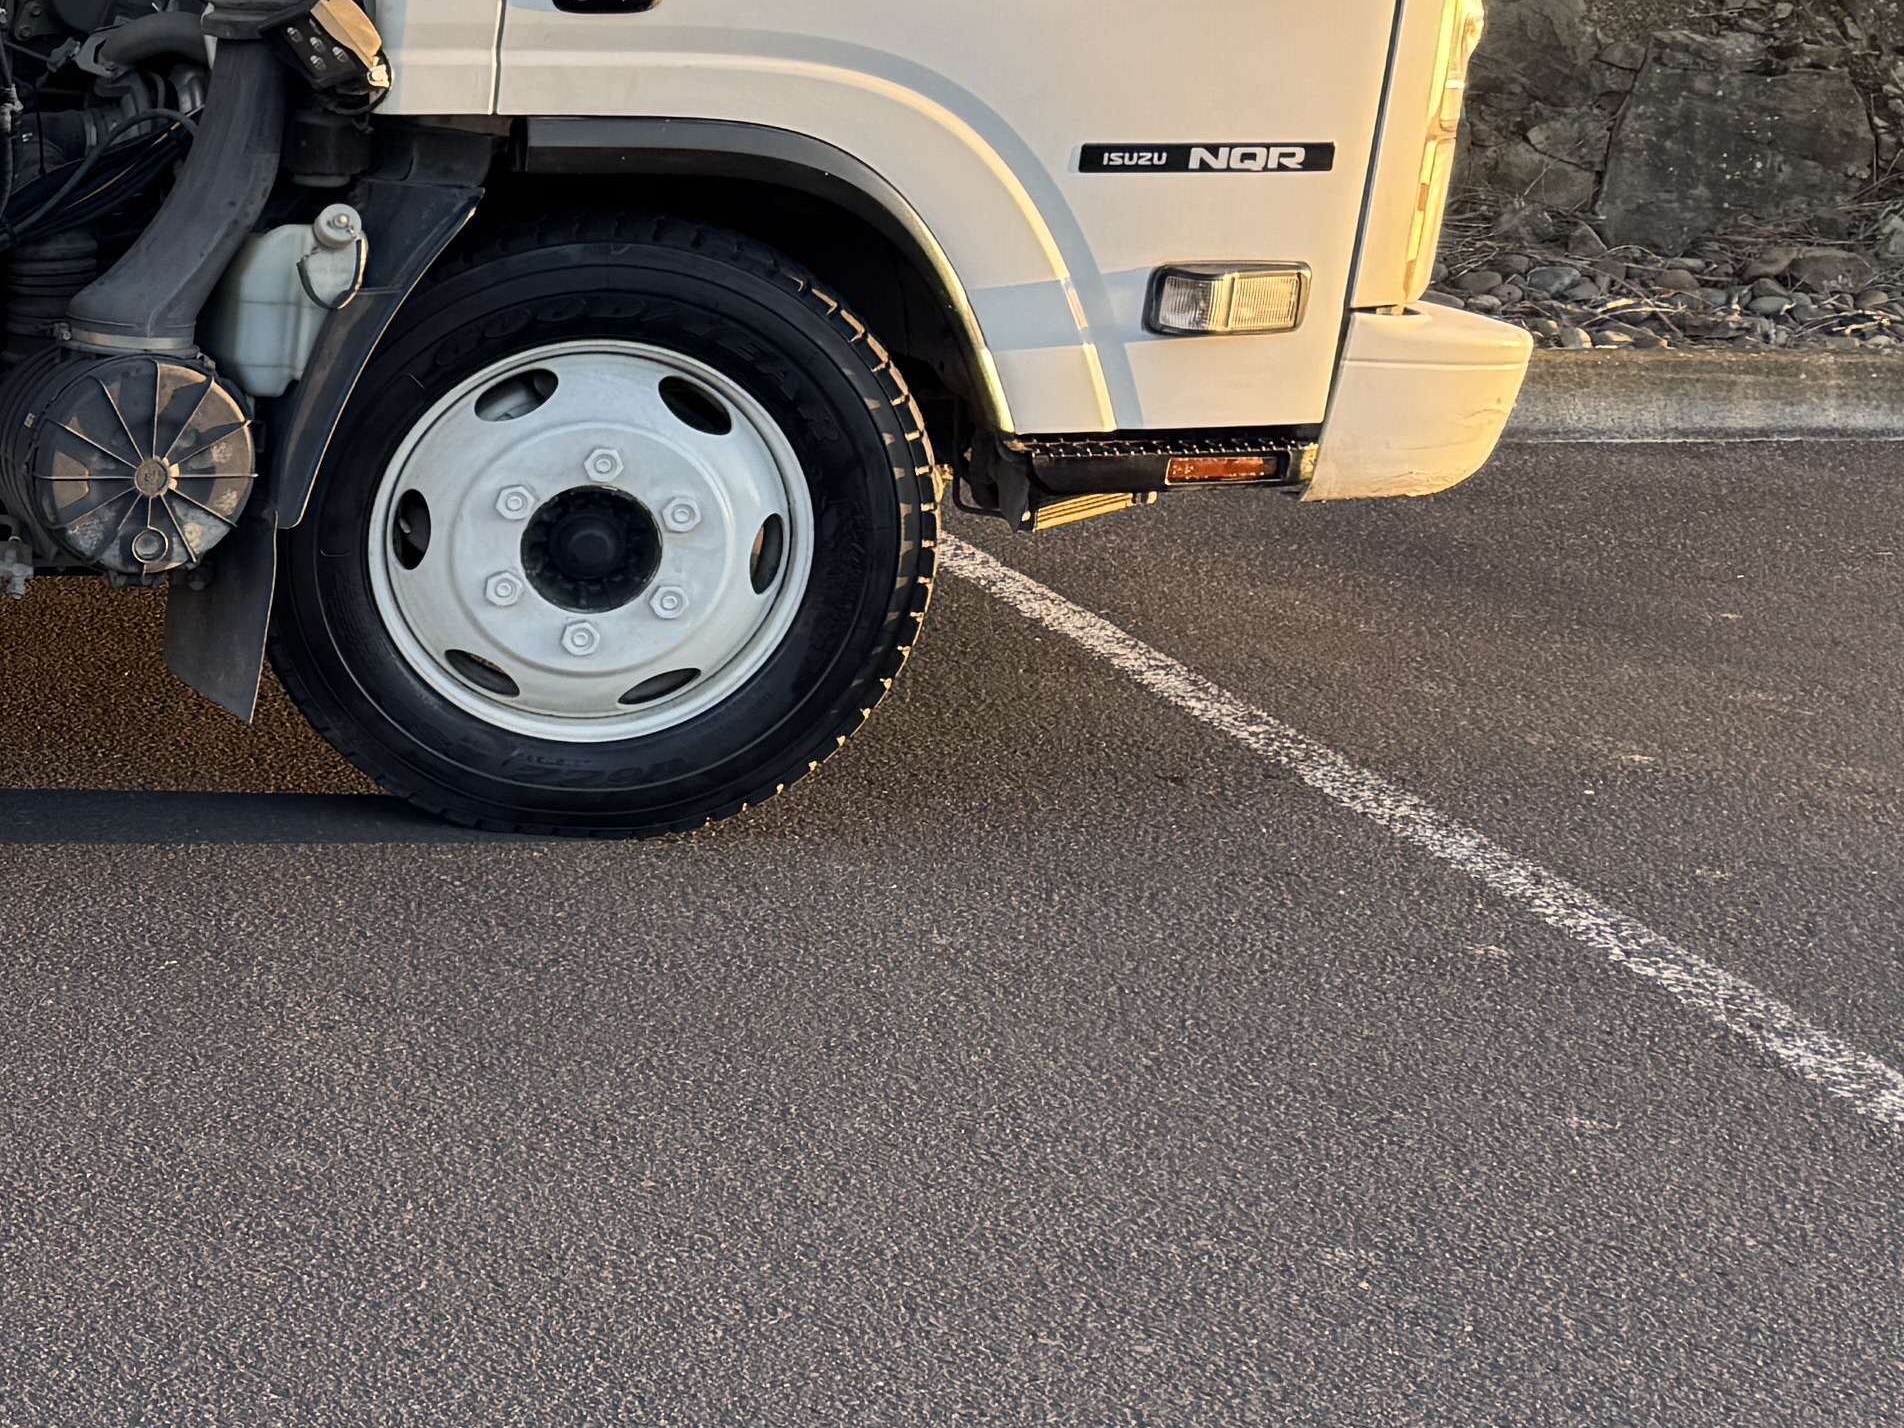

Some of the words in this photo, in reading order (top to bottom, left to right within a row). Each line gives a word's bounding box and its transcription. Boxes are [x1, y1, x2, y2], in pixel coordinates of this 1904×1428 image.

[1102, 151, 1167, 166] ISUZU
[1188, 147, 1306, 171] NQR
[435, 290, 840, 444] GOODYEAR
